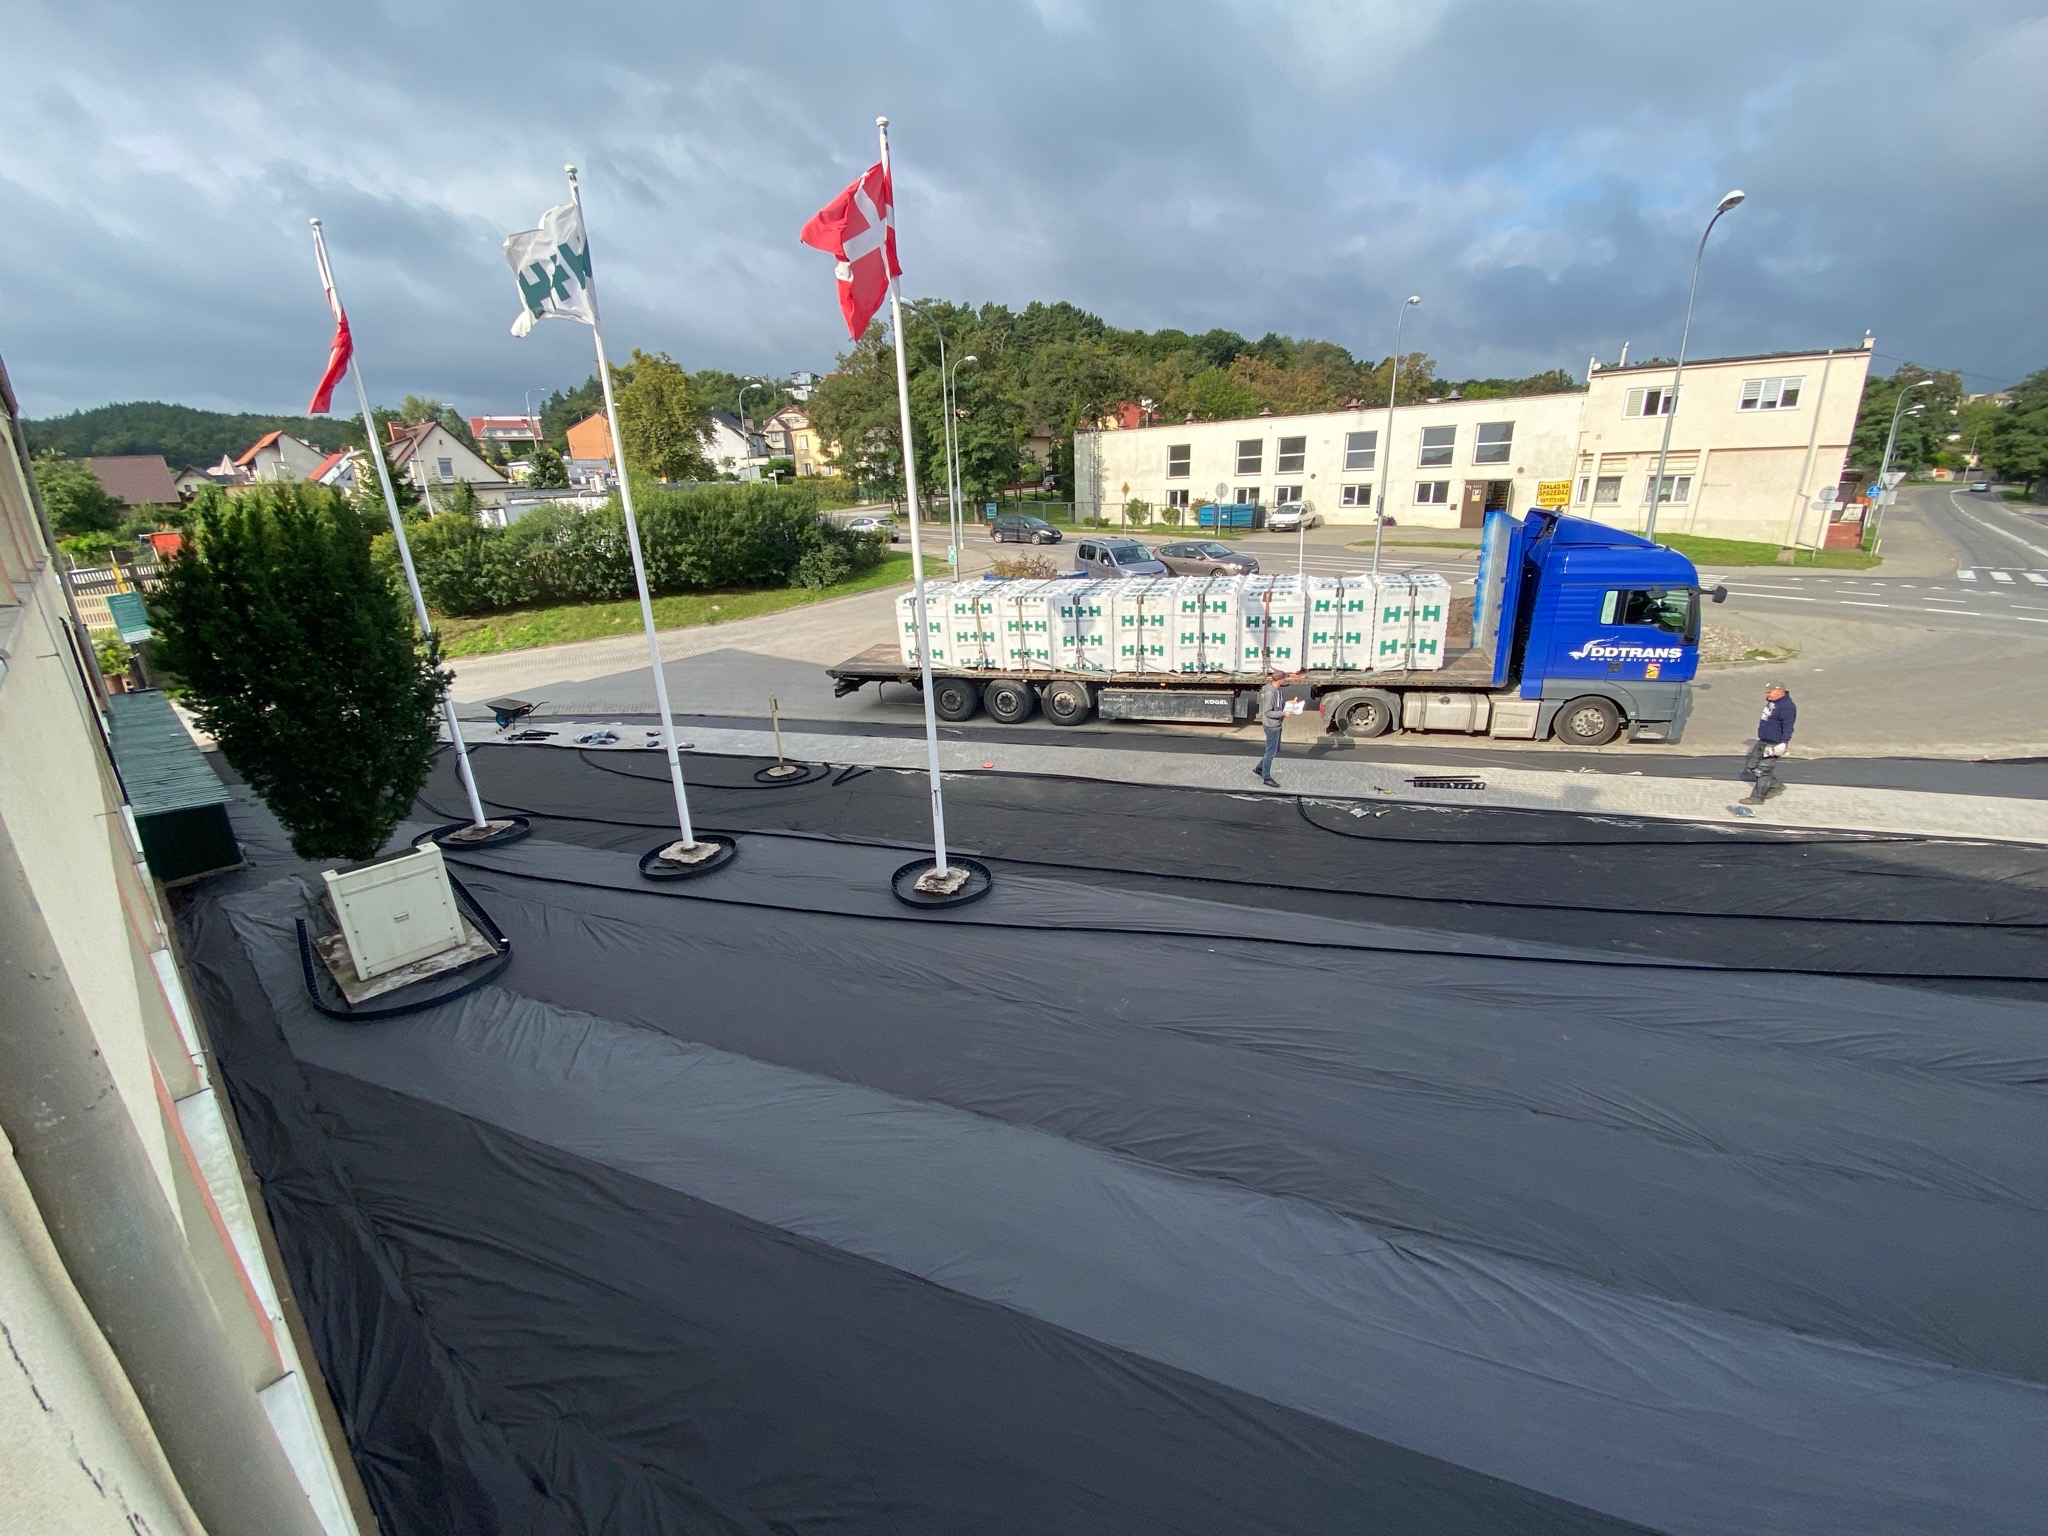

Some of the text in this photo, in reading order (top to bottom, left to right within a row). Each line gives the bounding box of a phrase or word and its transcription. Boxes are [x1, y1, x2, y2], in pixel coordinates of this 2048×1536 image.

[955, 603, 992, 614] H+H
[1061, 606, 1101, 617] H+H
[1182, 601, 1227, 613] H+H
[1315, 600, 1364, 612] H+H
[1382, 605, 1440, 623] H+H
[1121, 615, 1164, 626] H+H
[1246, 616, 1294, 628] H+H
[1008, 621, 1047, 632] H+H
[957, 631, 995, 642] H+H
[1063, 635, 1102, 647] H+H
[1180, 632, 1226, 645] H+H
[1313, 632, 1361, 644] H+H
[1122, 645, 1164, 656] H+H
[1245, 647, 1291, 658] H+H
[1380, 638, 1437, 656] H+H
[1590, 647, 1682, 658] DDTRANS
[1010, 649, 1048, 660] H+H
